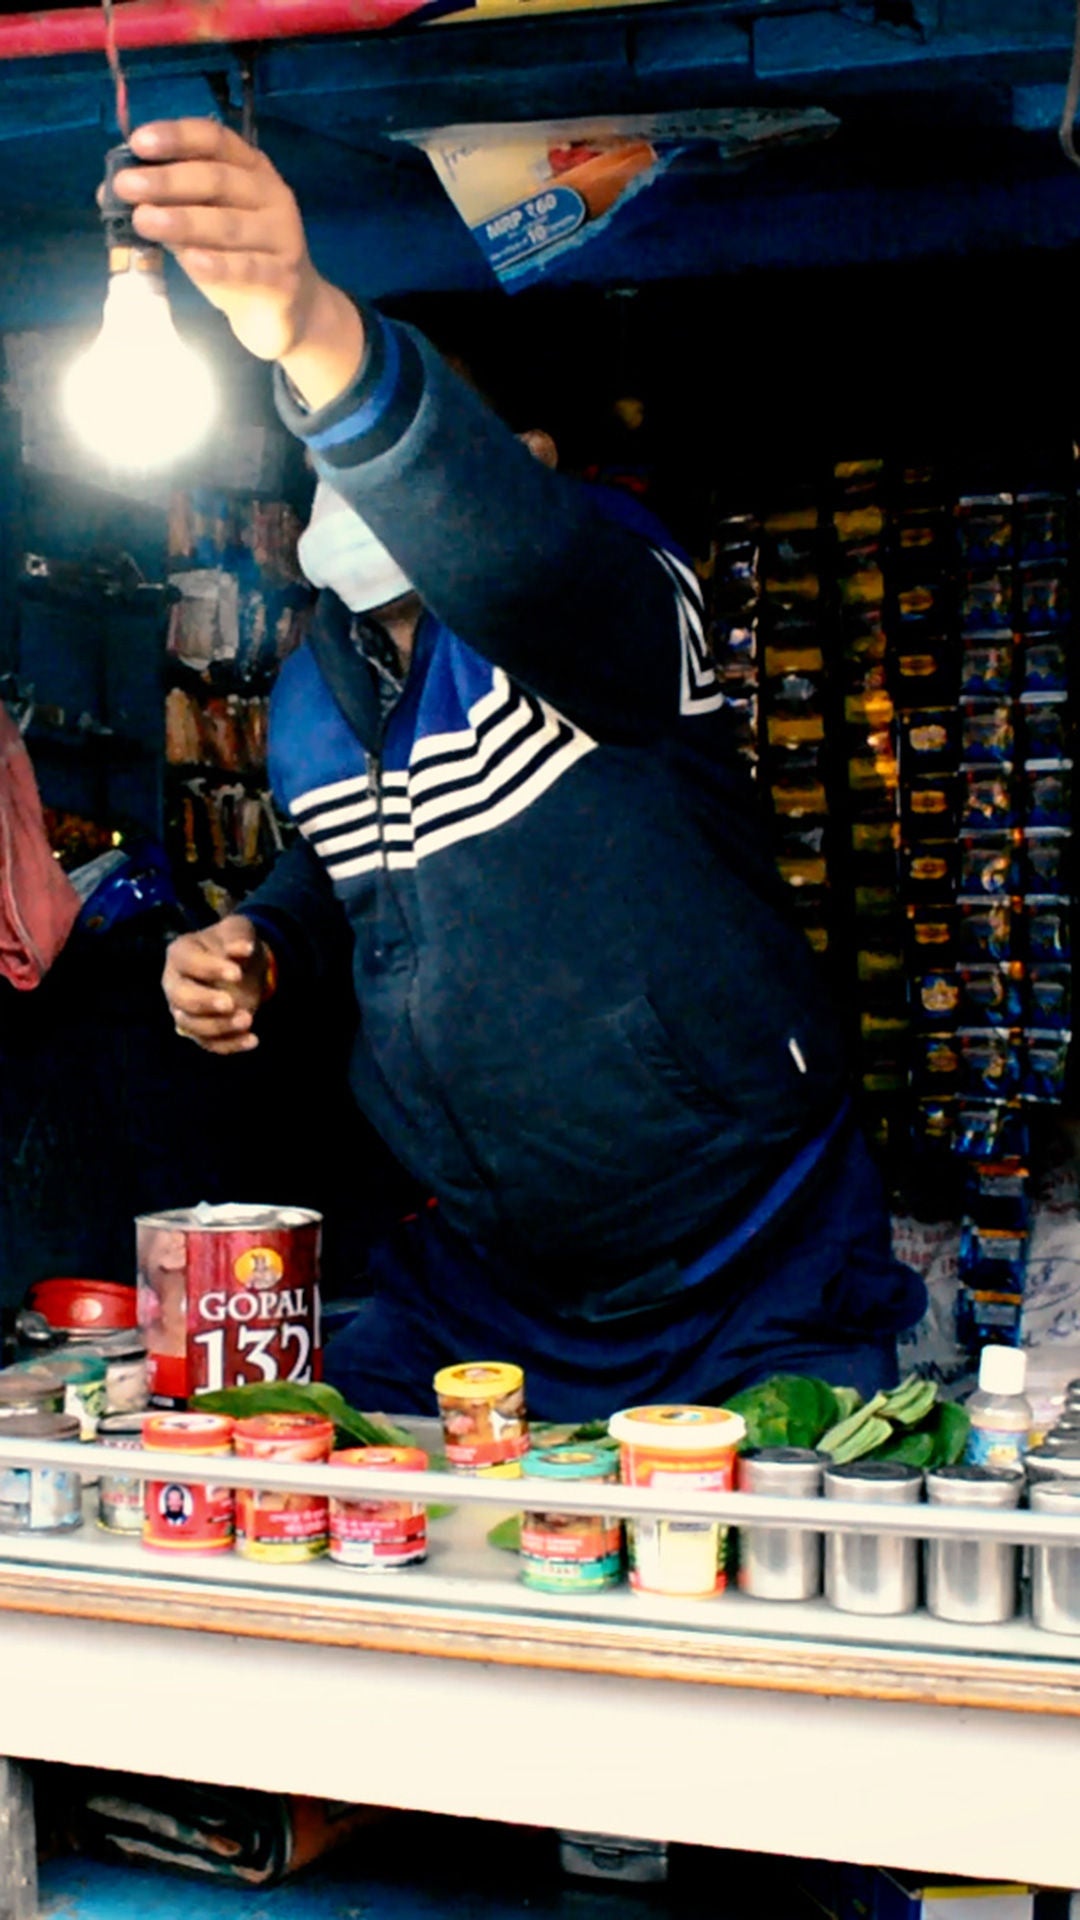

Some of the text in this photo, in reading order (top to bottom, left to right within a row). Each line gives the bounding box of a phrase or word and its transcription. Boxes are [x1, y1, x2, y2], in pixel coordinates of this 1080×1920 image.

[485, 210, 523, 240] MRP
[527, 224, 547, 245] 10
[198, 1288, 308, 1321] GOPAL
[194, 1323, 312, 1396] 132
